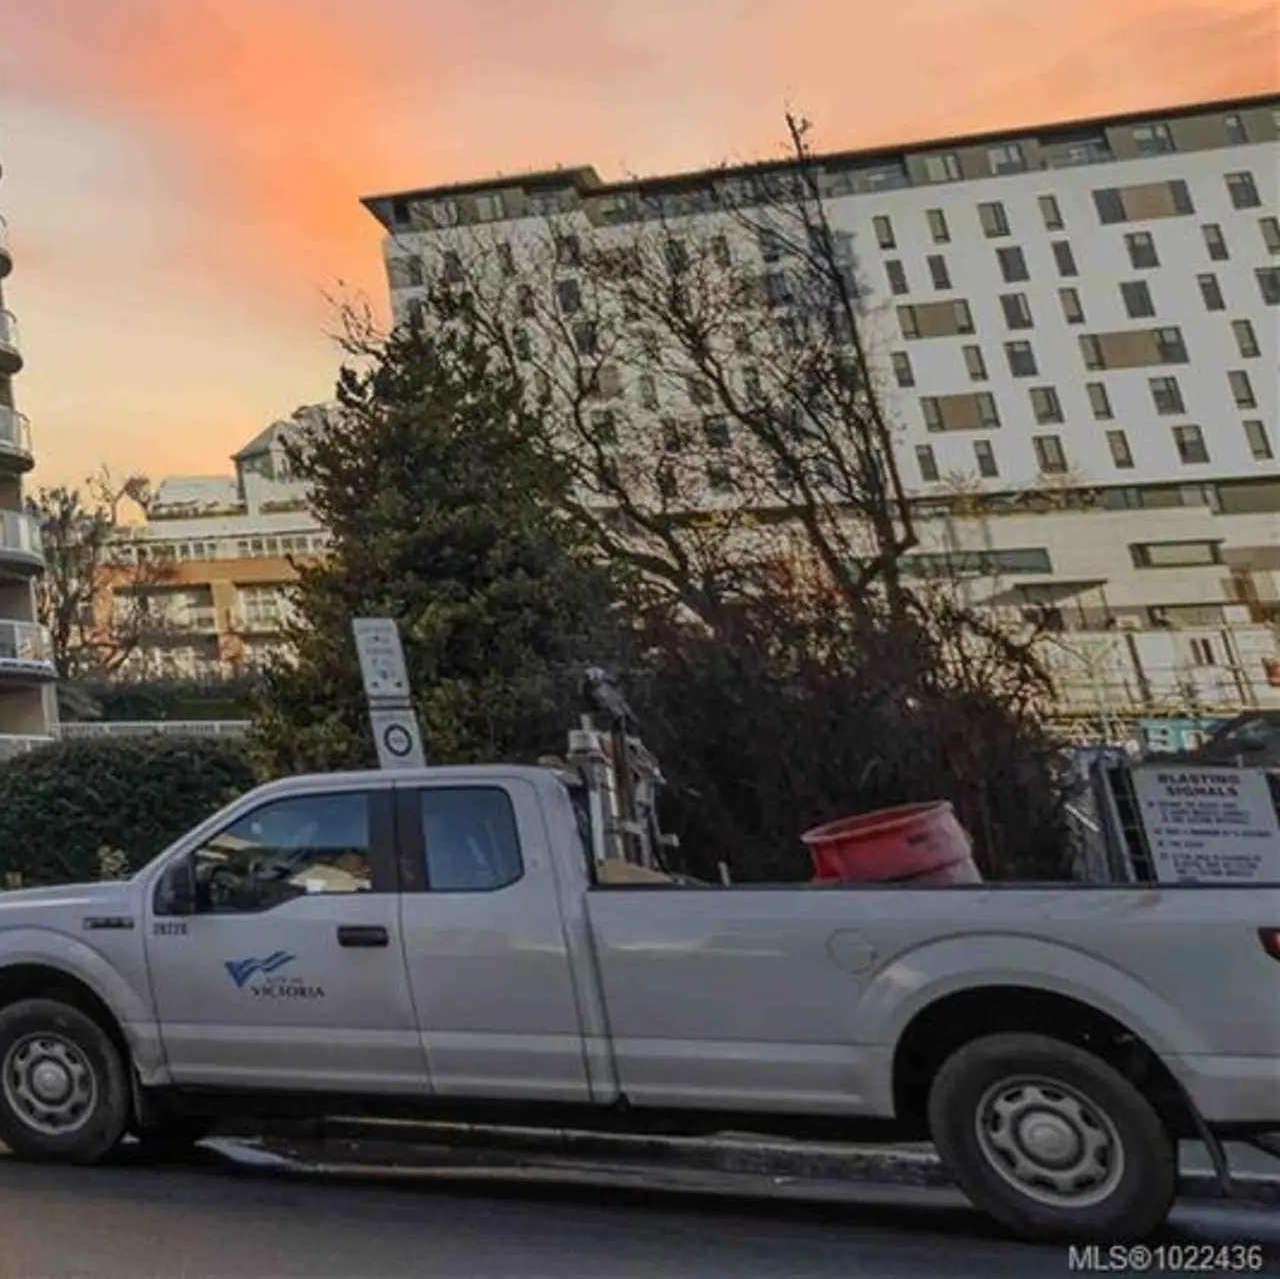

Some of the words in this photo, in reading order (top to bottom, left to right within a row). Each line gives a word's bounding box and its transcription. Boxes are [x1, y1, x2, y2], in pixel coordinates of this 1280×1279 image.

[1157, 772, 1240, 785] BLASTING
[1166, 785, 1239, 797] SIGNALS
[250, 985, 326, 997] VICTORIA
